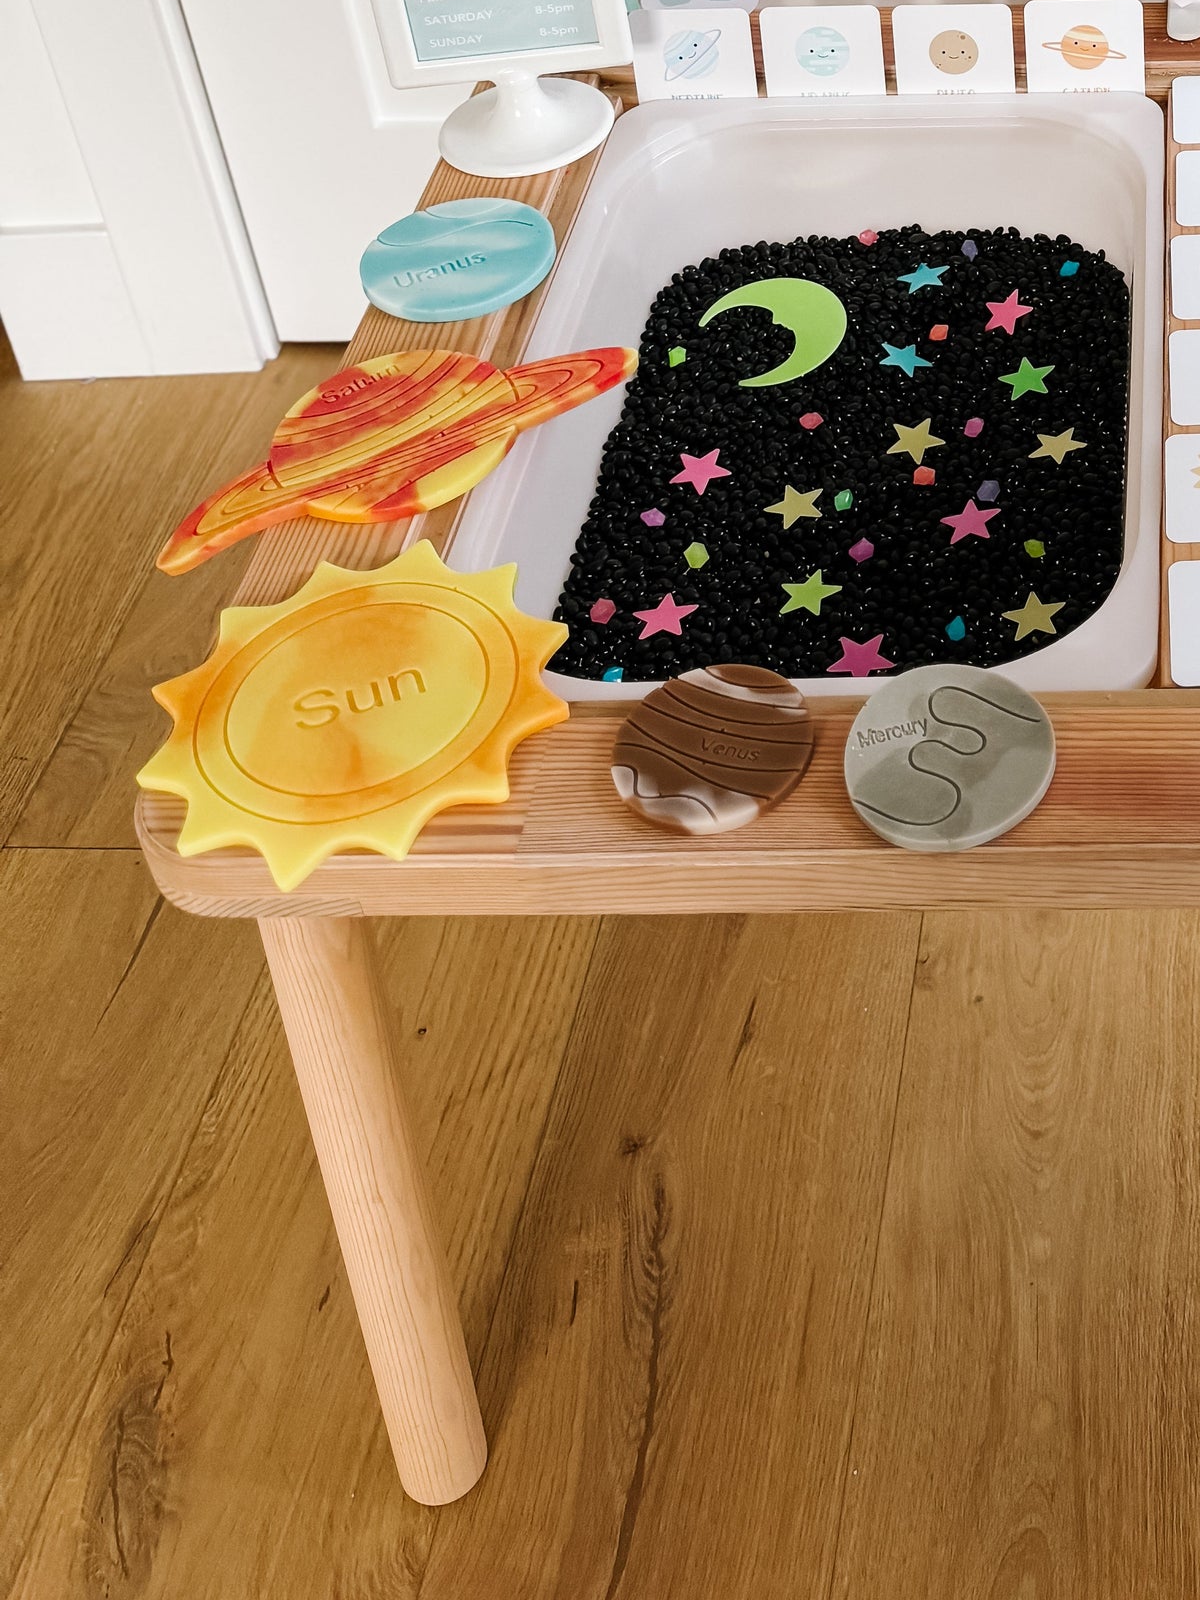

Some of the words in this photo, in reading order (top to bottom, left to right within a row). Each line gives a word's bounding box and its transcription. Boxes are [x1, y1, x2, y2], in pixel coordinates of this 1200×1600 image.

[424, 9, 493, 26] SATURDAY
[535, 3, 575, 15] 8-5pm
[430, 34, 483, 48] SUNDAY
[539, 25, 579, 38] 8-5pm
[393, 248, 488, 290] Uranus
[321, 364, 401, 404] Saturn
[292, 661, 428, 732] Sun
[857, 718, 928, 748] Mercury
[700, 737, 760, 762] Venus
